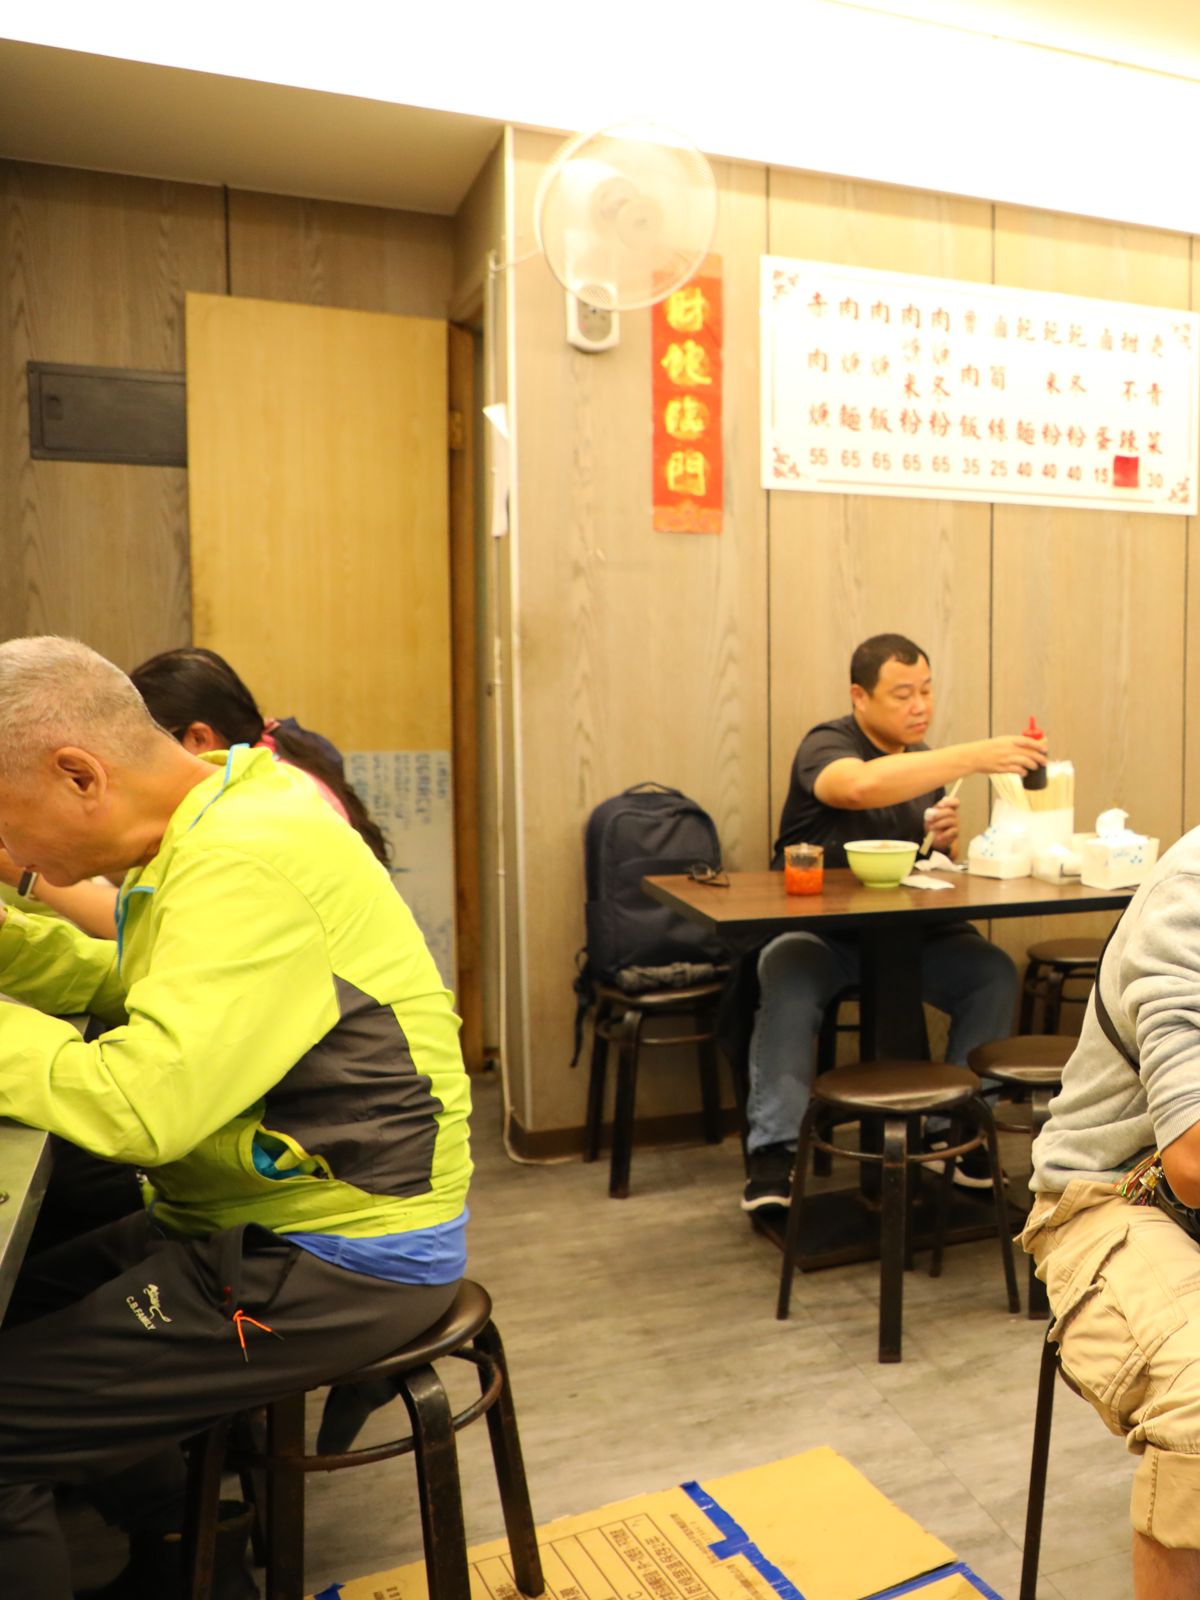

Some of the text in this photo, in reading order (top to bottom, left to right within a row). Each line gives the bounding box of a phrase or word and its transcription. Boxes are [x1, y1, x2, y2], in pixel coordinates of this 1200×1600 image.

[809, 447, 828, 465] 55
[841, 449, 861, 468] 65
[872, 451, 892, 470] 65
[902, 453, 921, 472] 65
[931, 455, 951, 474] 65
[962, 457, 980, 475] 35
[990, 460, 1008, 477] 25
[1016, 462, 1033, 478] 40
[1041, 464, 1058, 479] 40
[1066, 466, 1083, 481] 40
[1094, 467, 1109, 483] 15
